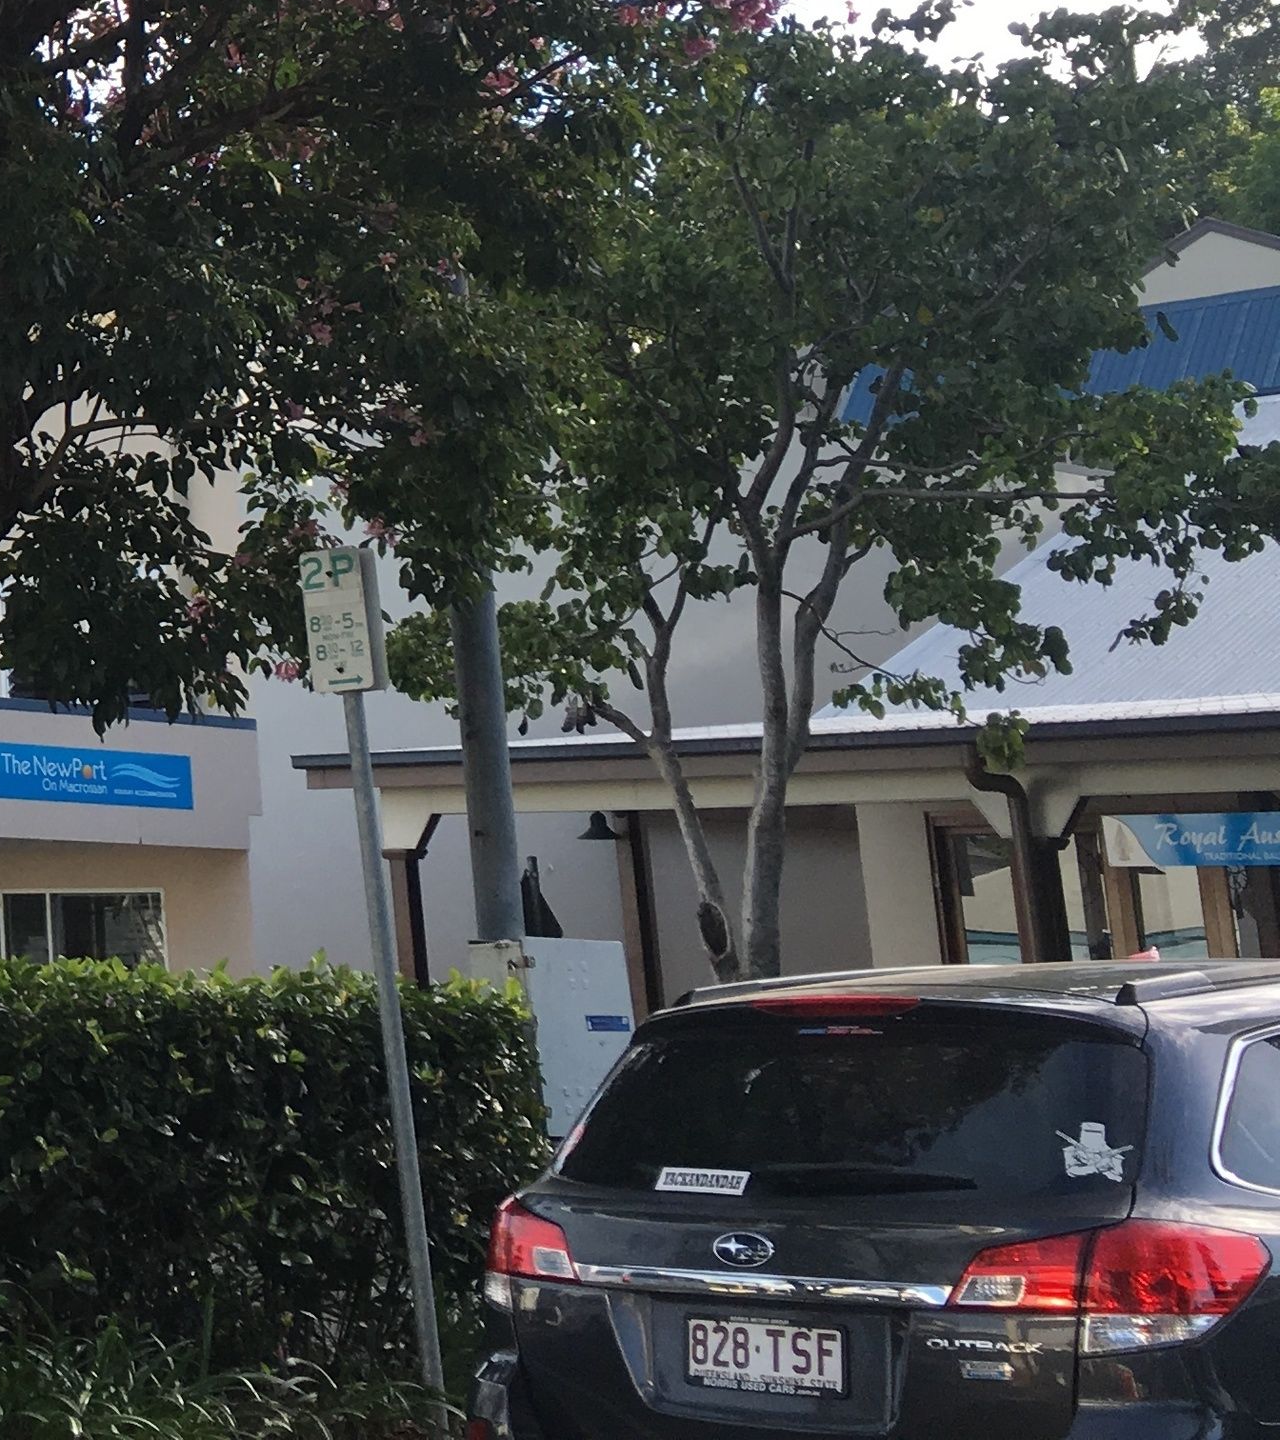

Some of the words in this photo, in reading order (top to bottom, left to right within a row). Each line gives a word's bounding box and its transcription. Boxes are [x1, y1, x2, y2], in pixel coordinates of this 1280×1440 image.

[301, 553, 355, 590] 2P
[1, 752, 31, 776] The
[33, 755, 108, 781] NewPort
[42, 778, 57, 791] On
[59, 779, 108, 795] Macrossan
[1154, 822, 1228, 854] Royal
[926, 1338, 1044, 1355] OUTBACK
[703, 1377, 738, 1390] NORRIS
[741, 1381, 766, 1392] USED
[768, 1383, 796, 1395] CARS
